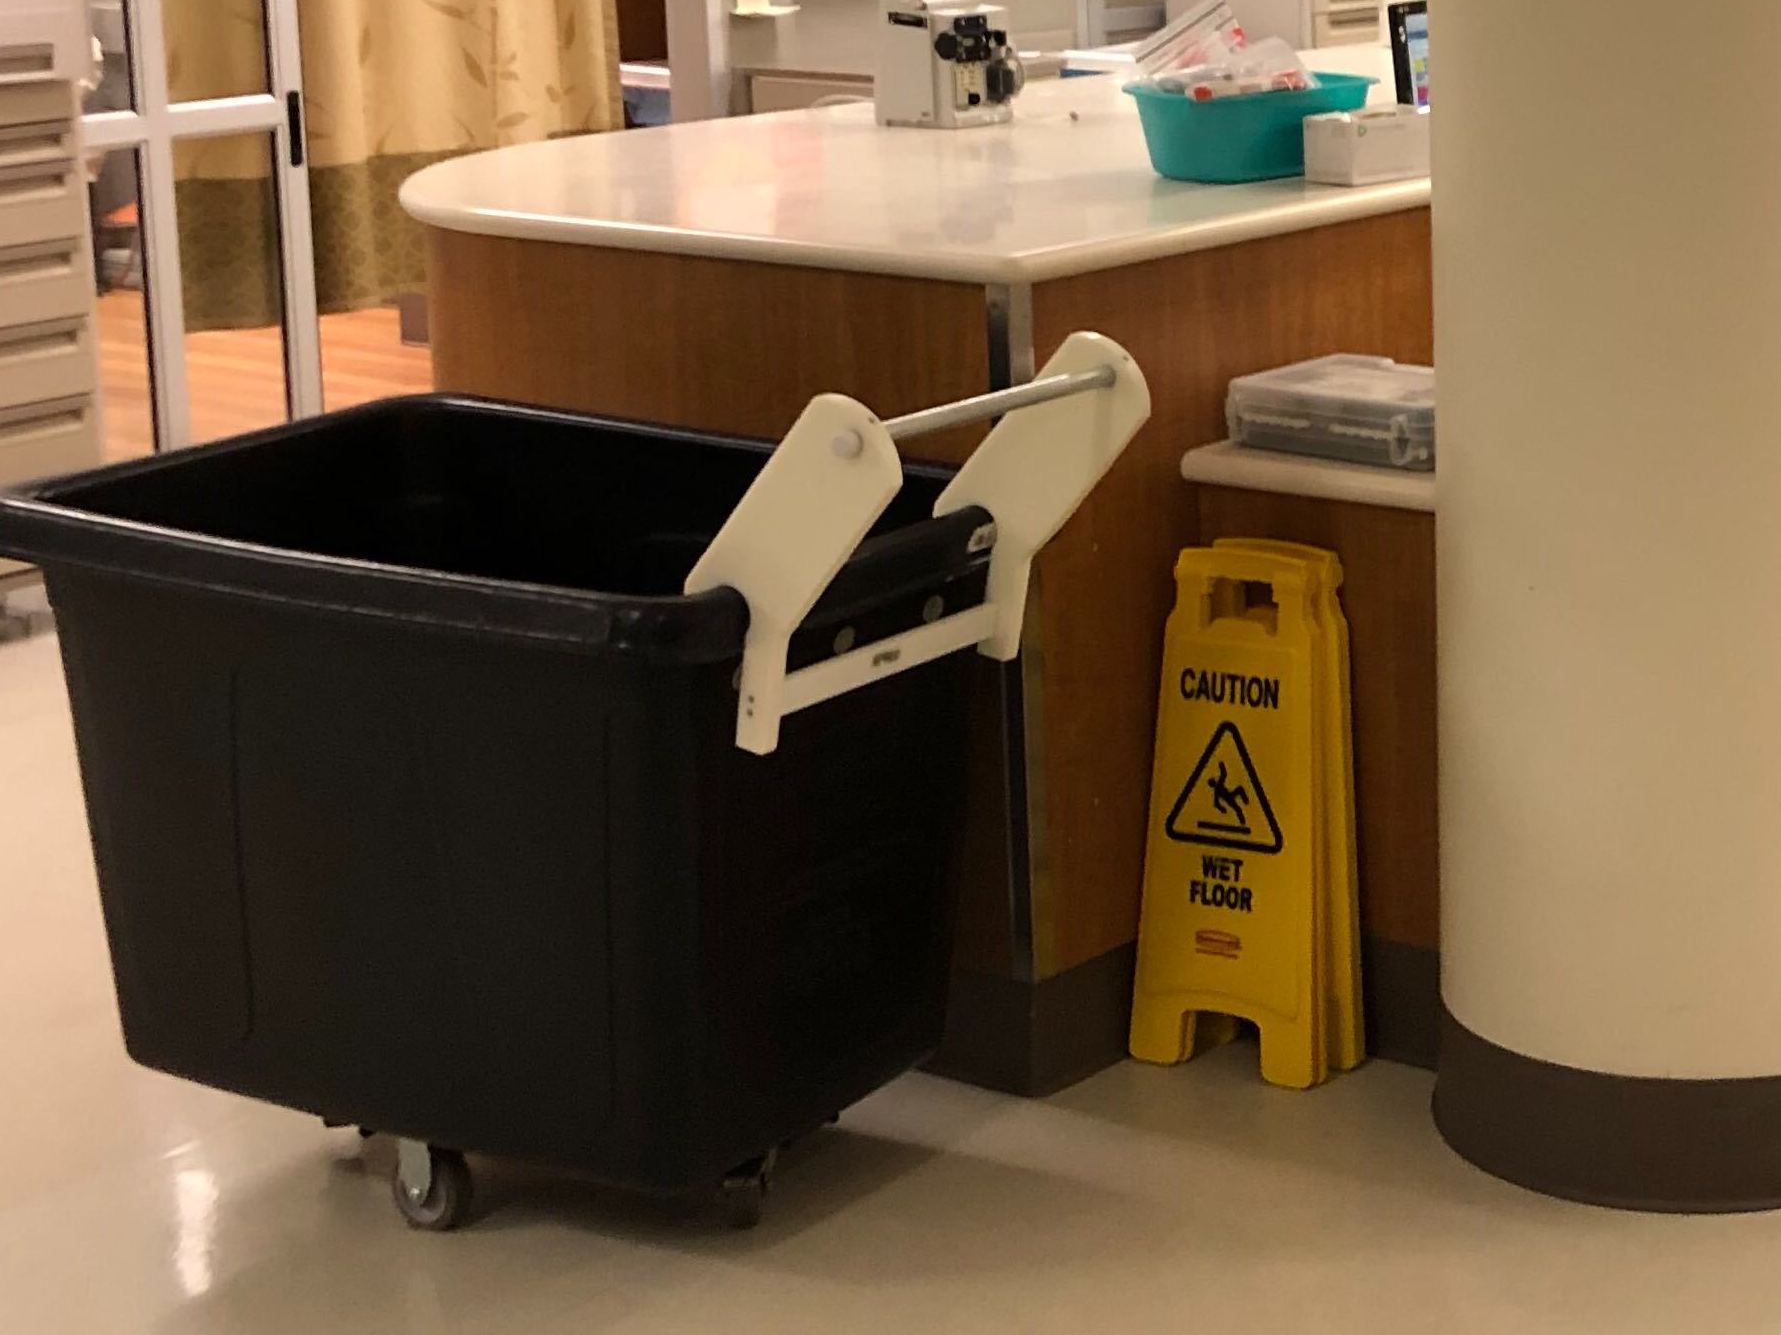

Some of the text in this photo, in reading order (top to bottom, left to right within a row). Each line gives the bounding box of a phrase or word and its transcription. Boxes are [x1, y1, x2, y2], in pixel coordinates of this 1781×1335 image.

[1181, 667, 1280, 710] CAUTION
[1202, 855, 1244, 882] WET
[1189, 880, 1253, 913] FLOOR
